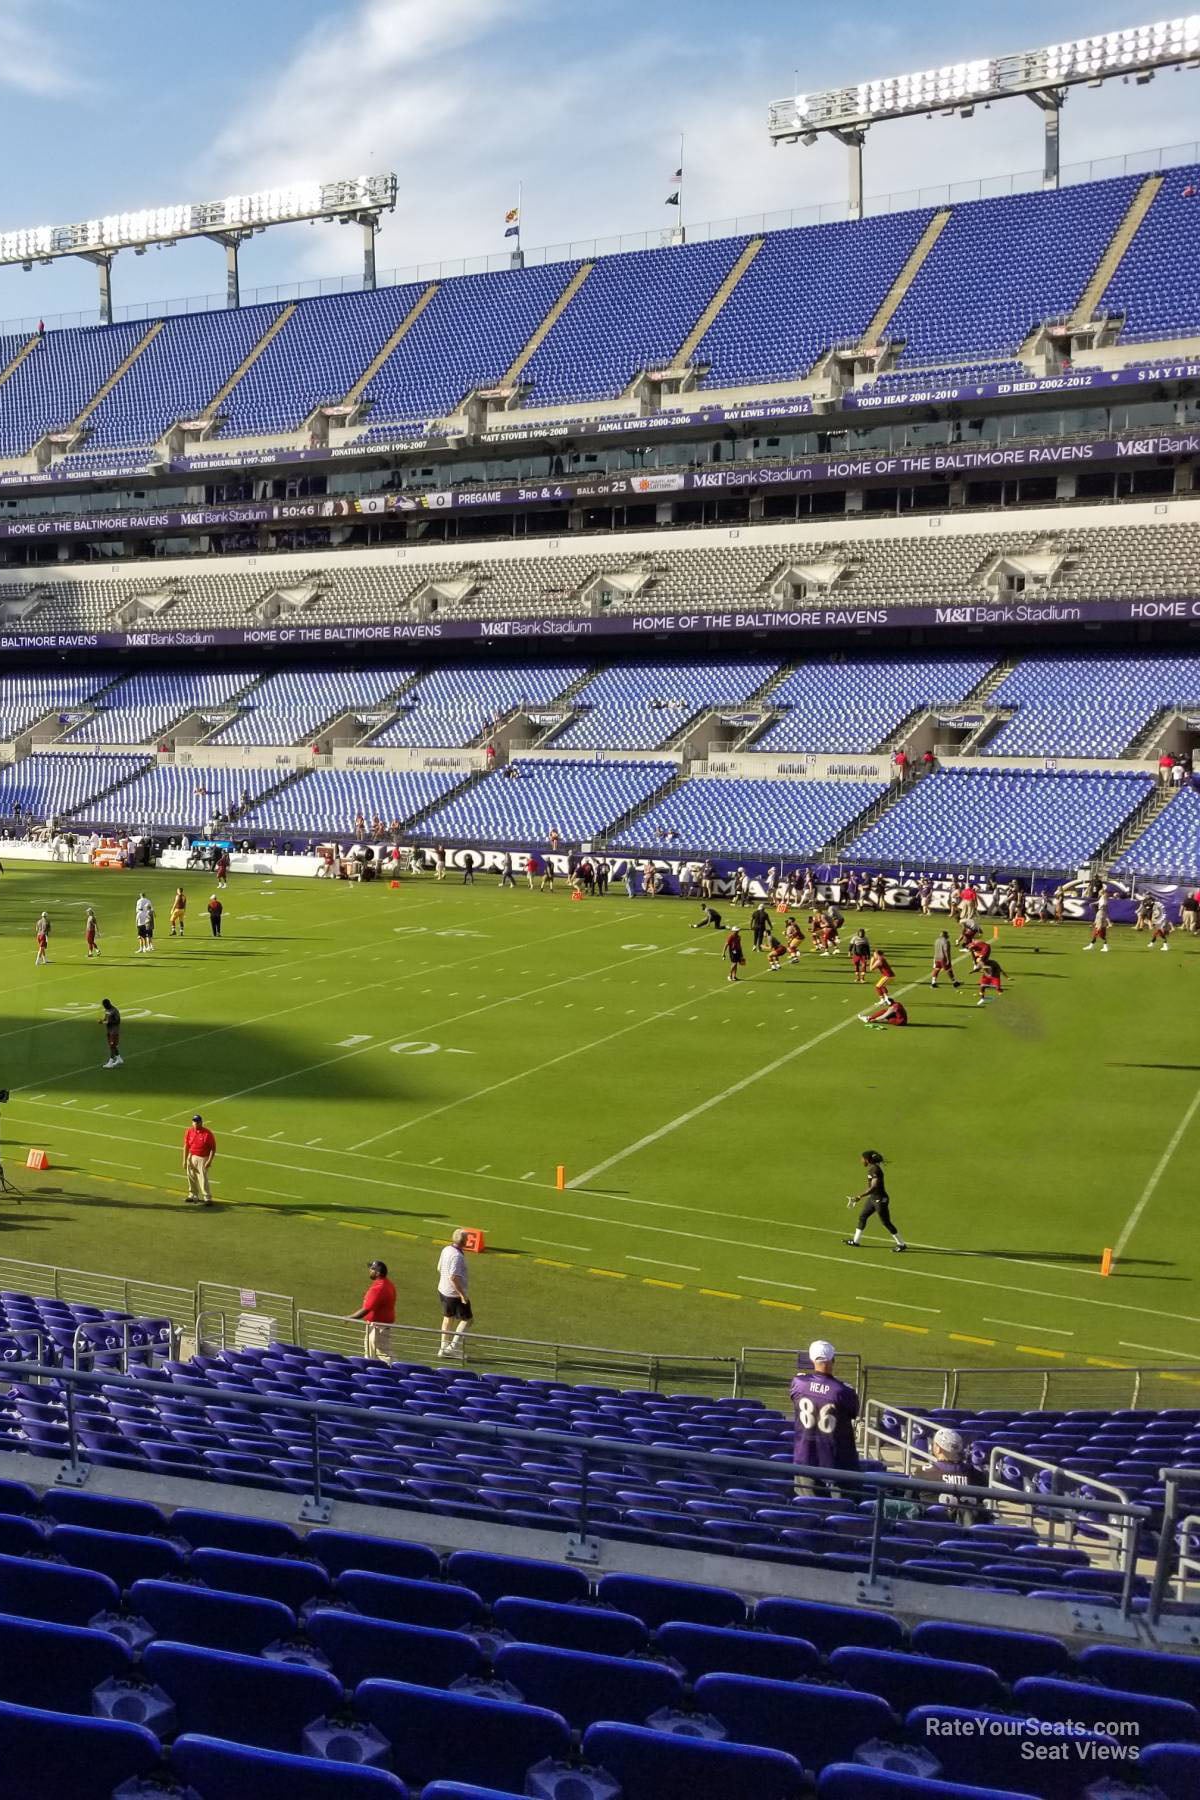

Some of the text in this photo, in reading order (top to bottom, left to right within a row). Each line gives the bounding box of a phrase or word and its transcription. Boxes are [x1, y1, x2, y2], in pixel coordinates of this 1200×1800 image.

[998, 376, 1092, 393] ED REED 2002-2012
[857, 390, 958, 407] TODD HEAP 2001-2010
[724, 404, 808, 420] RAY LEWIS 1996-2012
[597, 416, 691, 433] JAMAL LEWIS 2000-2006
[481, 433, 500, 442] MATT
[500, 431, 528, 441] STOVER
[331, 440, 427, 458] JONATHAN OGDEN 1996-2007
[1116, 436, 1200, 457] M&T Bank
[190, 460, 209, 470] PETER
[209, 458, 242, 468] BOULWARE
[693, 445, 1093, 487] M&T Bank Stadium HOME OF THE BALTIMORE RAVENS
[1, 476, 22, 484] ARTHUR
[30, 474, 52, 483] MODELL
[66, 471, 90, 480] MICHAEL
[458, 486, 563, 504] PREGAME 3RD & 4
[577, 481, 627, 496] BALL ON 25
[181, 495, 445, 525] M&T Bank Stadium 50:46 0 0
[8, 524, 36, 535] HOME
[37, 522, 52, 534] OF
[53, 521, 72, 533] THE
[74, 518, 128, 531] BALTIMORE
[130, 515, 169, 528] RAVENS
[935, 602, 1200, 623] M&T Bank Stadium HOME O
[480, 610, 888, 636] M&T Bank Stadium HOME OF THE BALTIMORE RAVENS
[1, 636, 56, 648] BALTIMORE
[58, 635, 97, 646] RAVENS
[126, 625, 442, 646] M&T Bank Stadium HOME OF THE BALTIMORE RAVENS
[899, 870, 986, 882] BALTIMORE
[329, 1034, 441, 1055] 10
[29, 1151, 43, 1166] 10
[810, 1381, 830, 1395] HEAP
[798, 1396, 837, 1434] 86
[942, 1473, 968, 1487] SMITH
